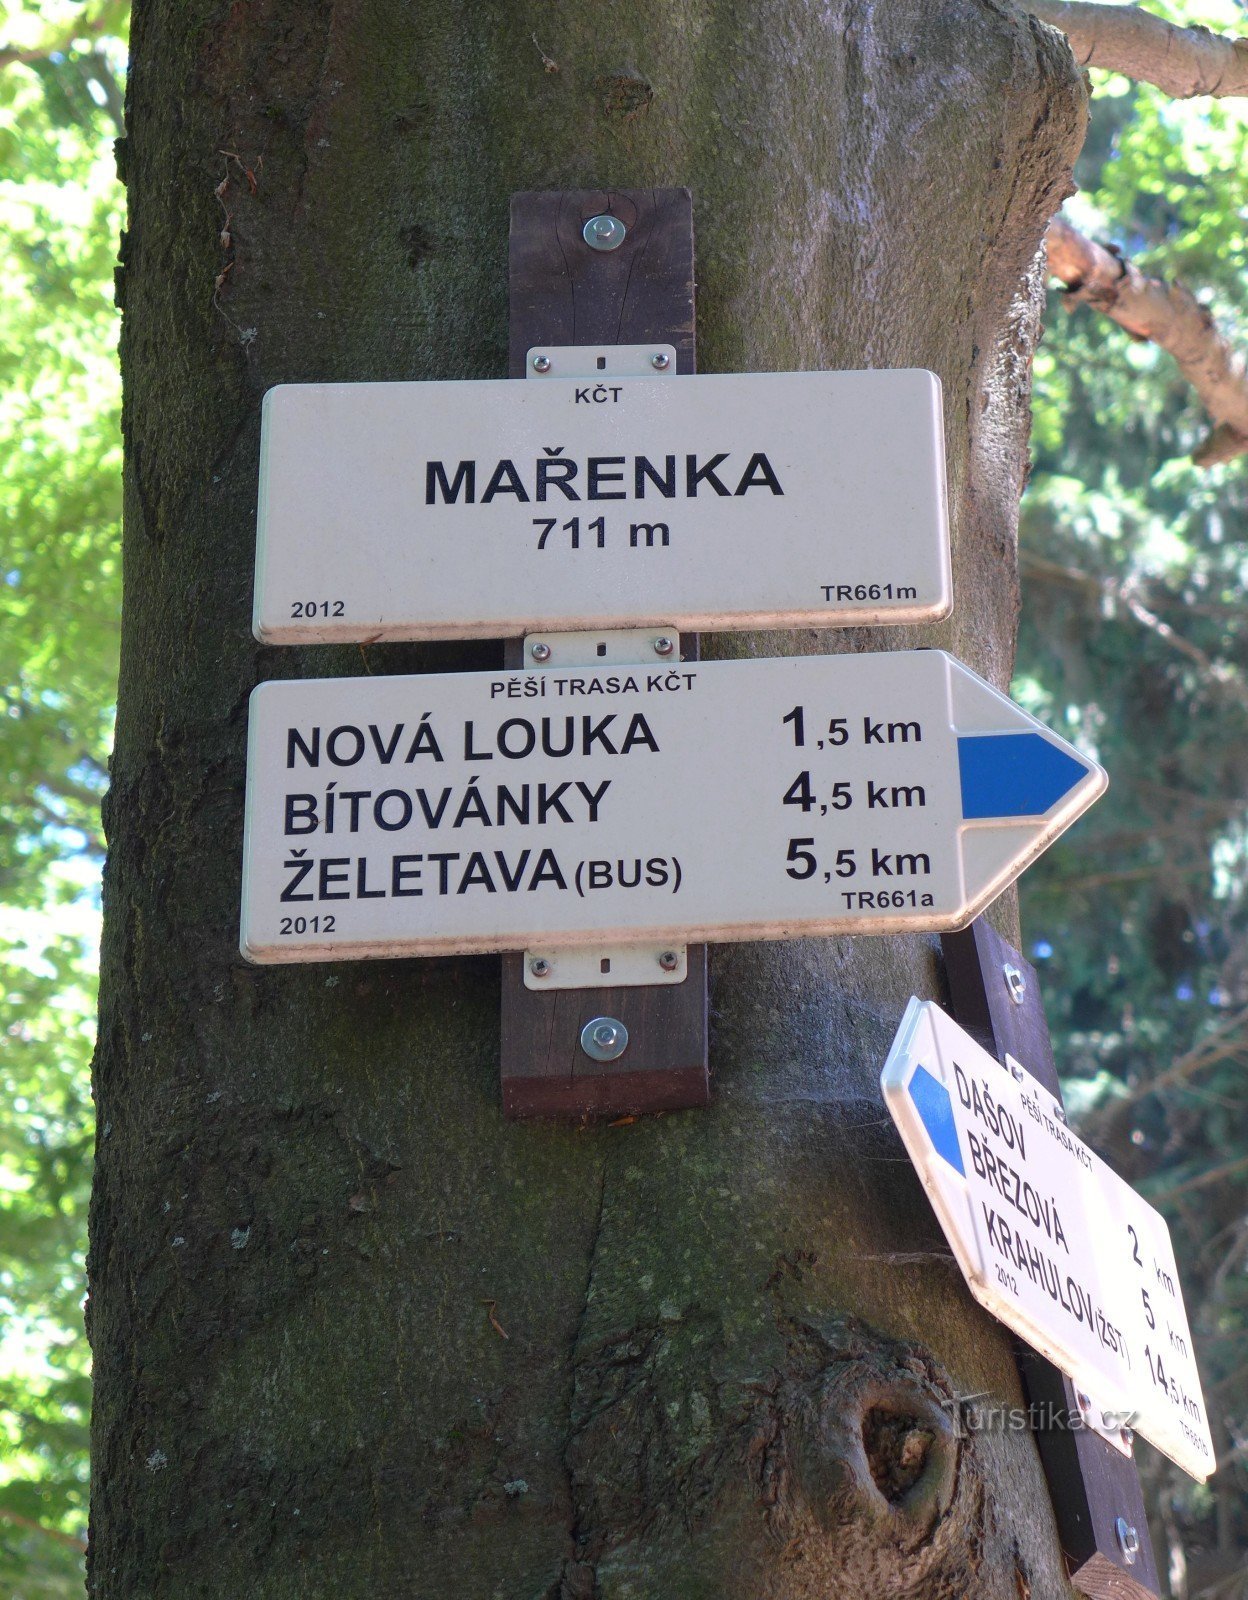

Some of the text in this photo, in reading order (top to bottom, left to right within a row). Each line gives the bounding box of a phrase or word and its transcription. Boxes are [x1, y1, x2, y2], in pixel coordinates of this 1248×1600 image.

[574, 383, 623, 404] KČT
[425, 446, 785, 505] MAŘENKA
[532, 516, 670, 550] 711 m
[290, 600, 345, 619] 2012
[820, 583, 917, 602] TR661m
[490, 670, 697, 699] PĚŠÍ TRASA KČT
[286, 711, 661, 769] NOVÁ LOUKA
[782, 705, 922, 751] 1,5 km
[284, 775, 612, 836] BÍTOVÁNKY
[782, 770, 926, 817] 4,5 km
[785, 837, 931, 884] 5,5 km
[841, 889, 934, 910] TR661a
[279, 915, 336, 935] 2012
[953, 1061, 1026, 1161] DAŠOV
[1020, 1093, 1093, 1172] PĚŠÍ TRASA KČT
[967, 1129, 1070, 1254] BŘEZOVÁ
[995, 1263, 1019, 1297] 2012
[1127, 1224, 1175, 1297] 2 km
[1141, 1287, 1187, 1359] 5 km
[1180, 1384, 1201, 1424] km
